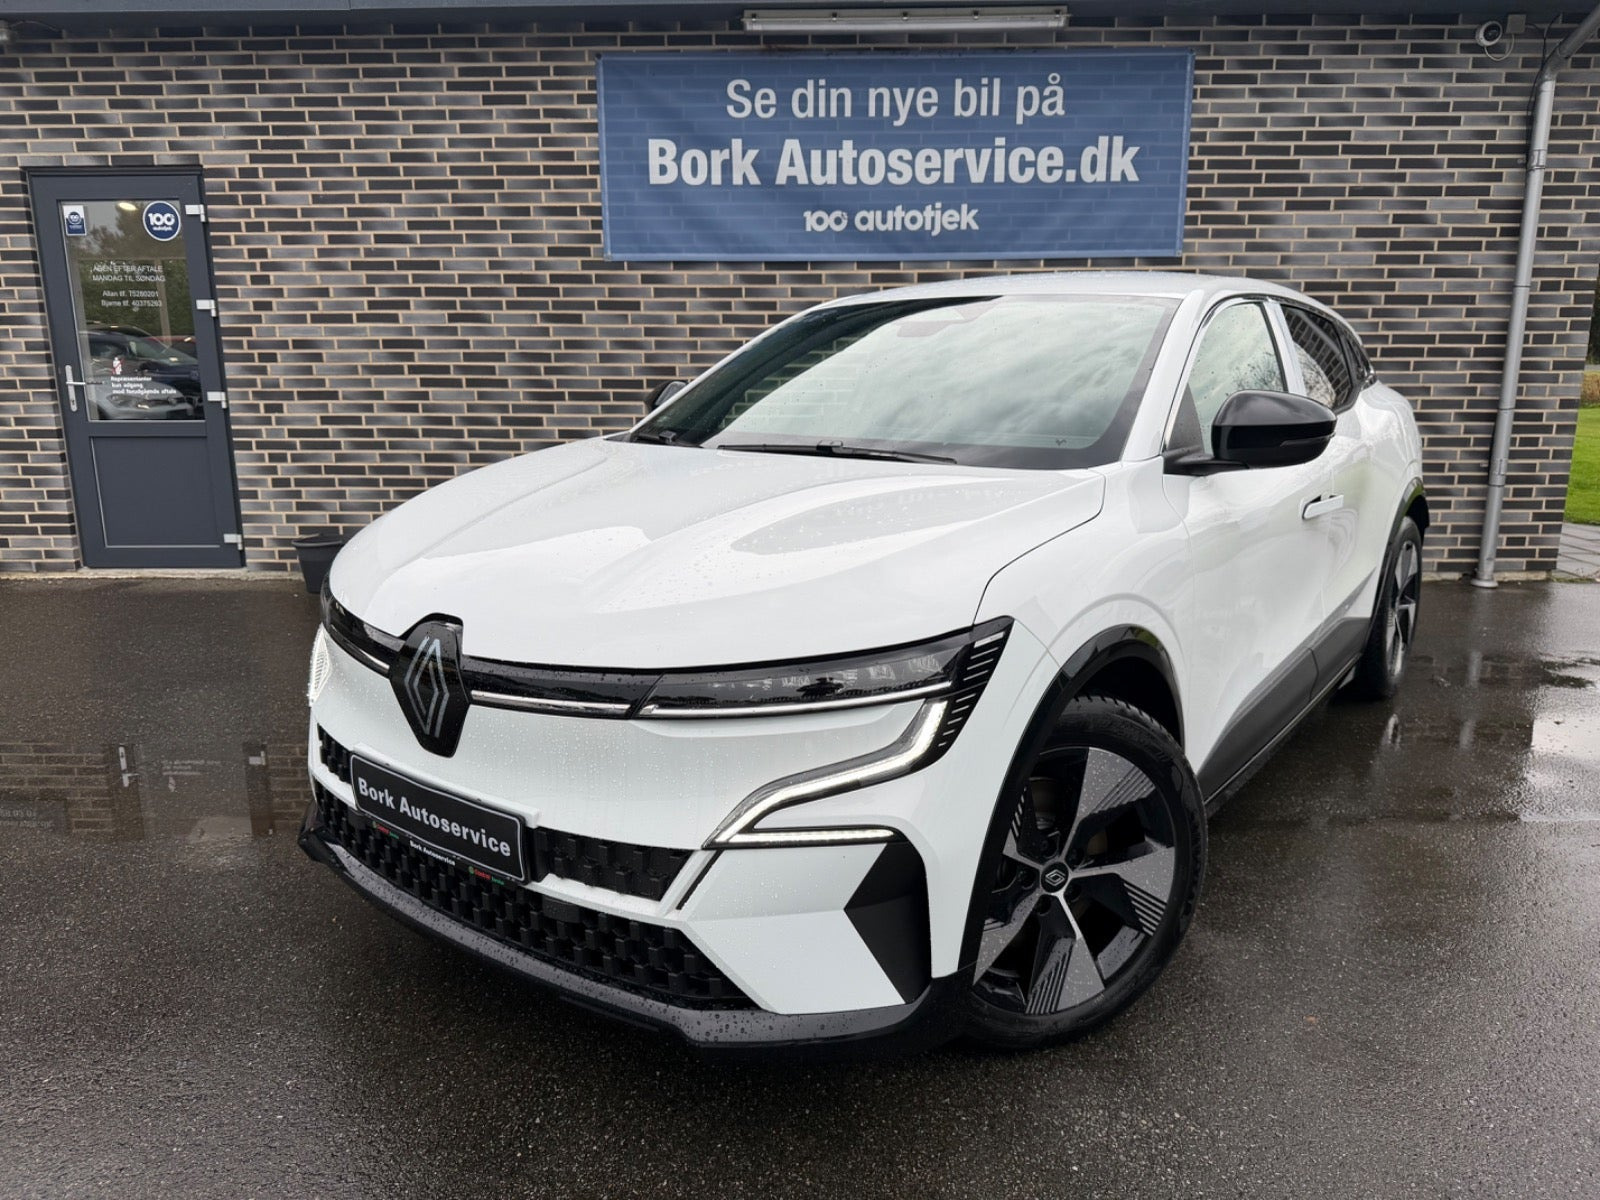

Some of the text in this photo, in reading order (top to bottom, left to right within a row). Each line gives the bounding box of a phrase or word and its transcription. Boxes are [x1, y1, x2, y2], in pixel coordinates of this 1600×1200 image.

[727, 72, 1065, 126] Se din nye bil på
[648, 135, 1141, 186] Bork Autoservice.dk
[148, 212, 176, 226] 100
[803, 202, 979, 237] 100 autotjek
[92, 274, 122, 282] MANDAG
[124, 274, 133, 282] TIL
[136, 264, 163, 273] AFTALE
[358, 777, 511, 857] Bork Autoservice
